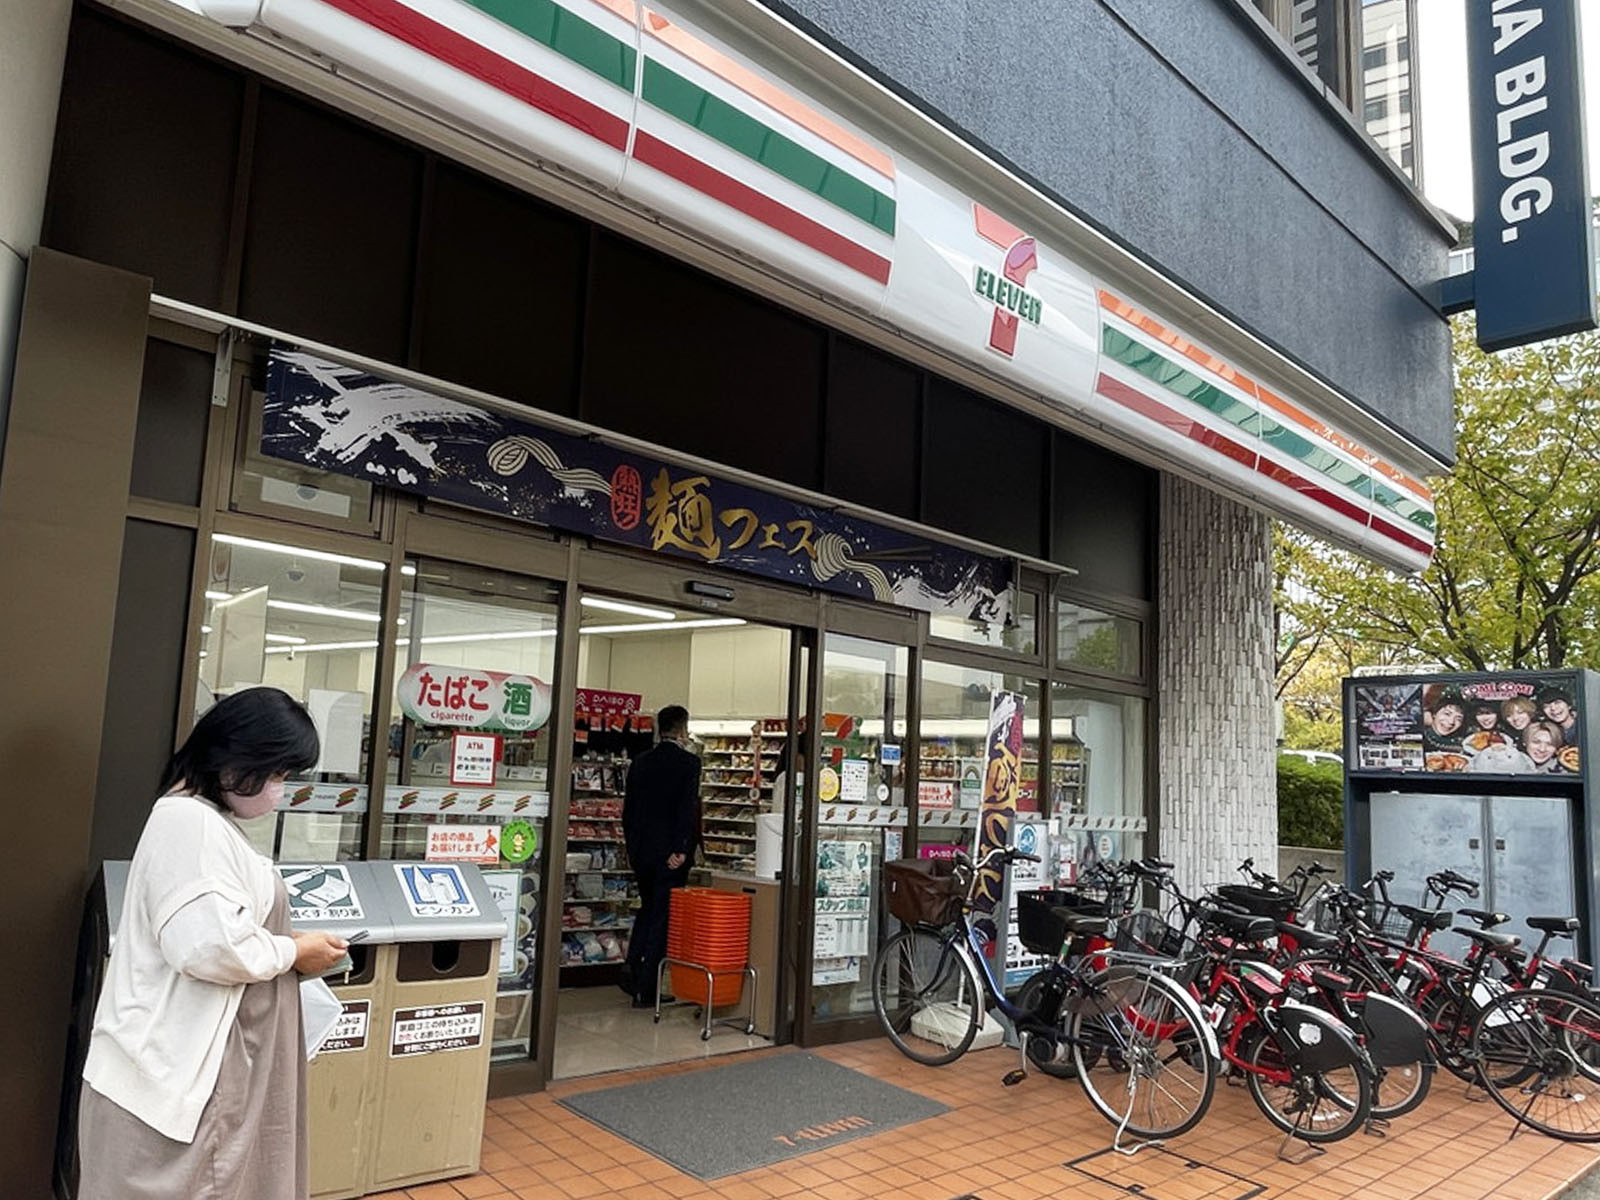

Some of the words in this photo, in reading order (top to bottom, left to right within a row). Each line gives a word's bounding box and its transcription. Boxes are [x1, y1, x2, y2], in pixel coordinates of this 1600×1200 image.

[1495, 55, 1553, 243] BLDG.
[645, 466, 818, 560] 麺フェス
[418, 672, 489, 711] たばこ
[503, 681, 533, 716] 酒
[430, 709, 475, 722] cigarette
[466, 742, 485, 750] ATM
